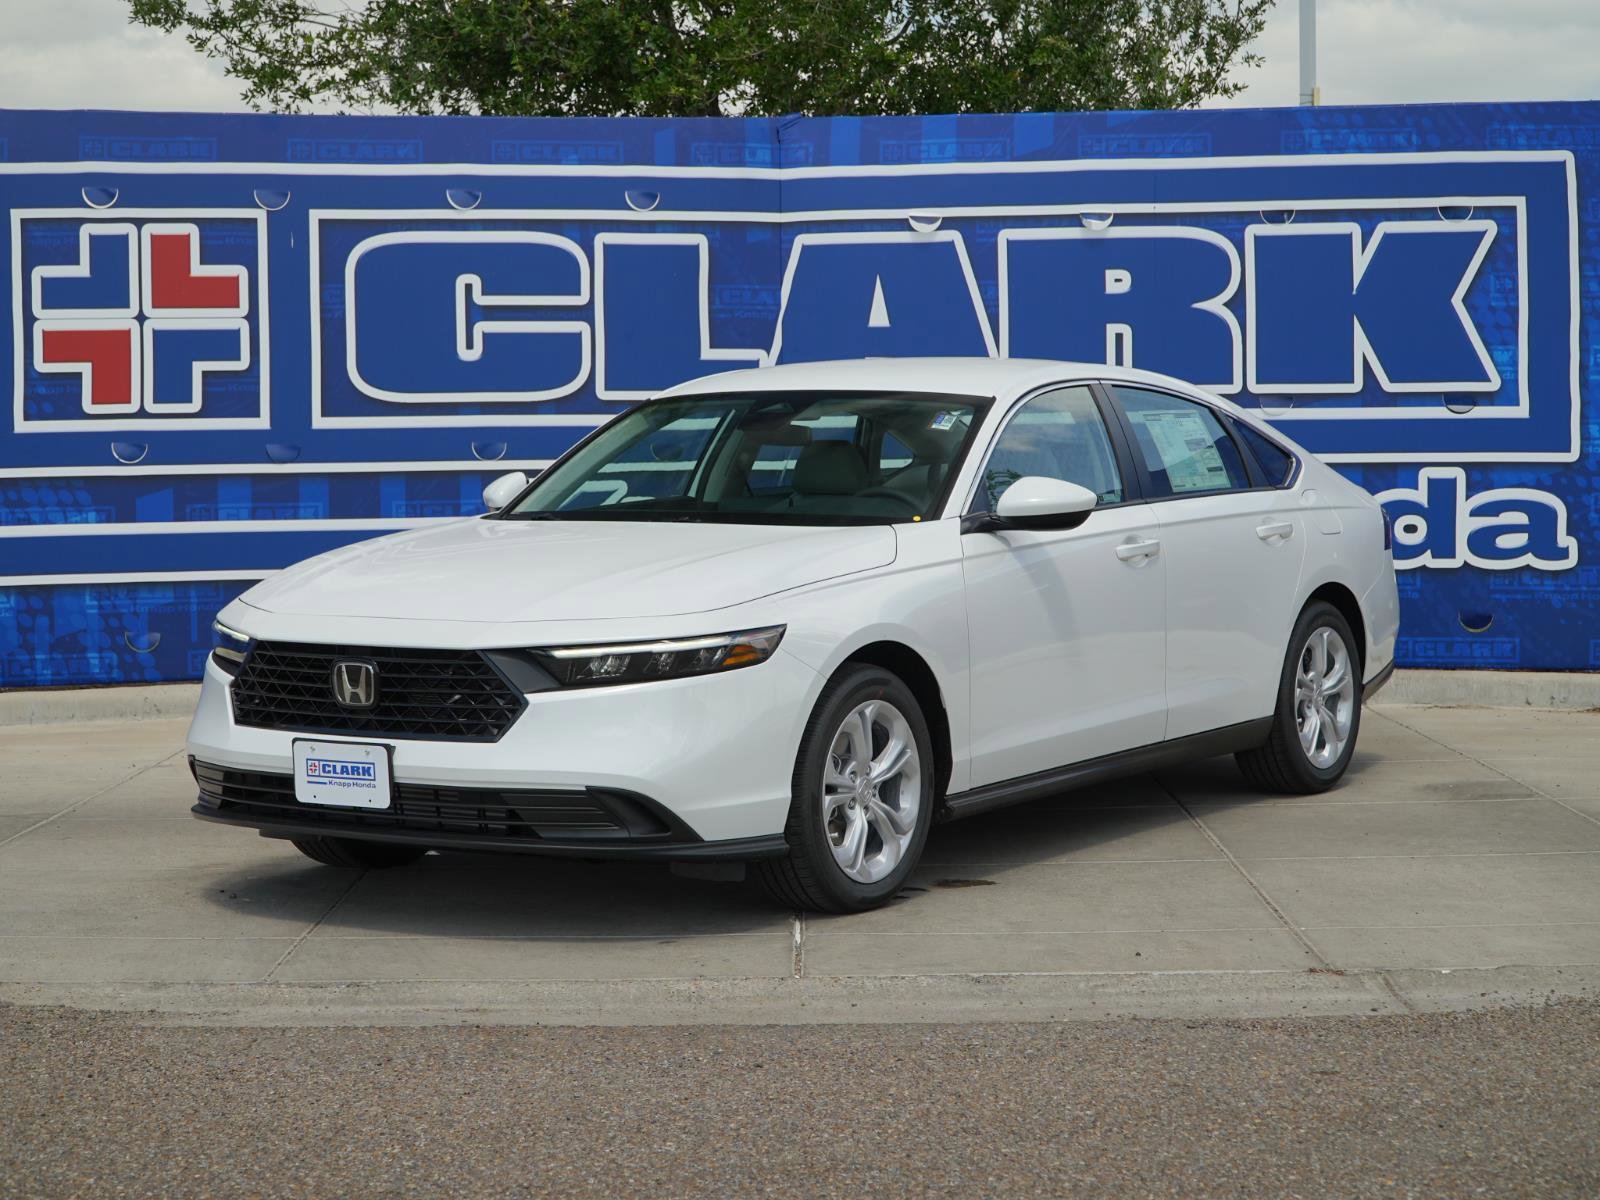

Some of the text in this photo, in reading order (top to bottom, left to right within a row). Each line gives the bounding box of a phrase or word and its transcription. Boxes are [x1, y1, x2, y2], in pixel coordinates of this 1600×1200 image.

[344, 219, 1502, 404] CLARK
[321, 763, 372, 777] CLARK
[328, 780, 376, 789] Knapp Honda
